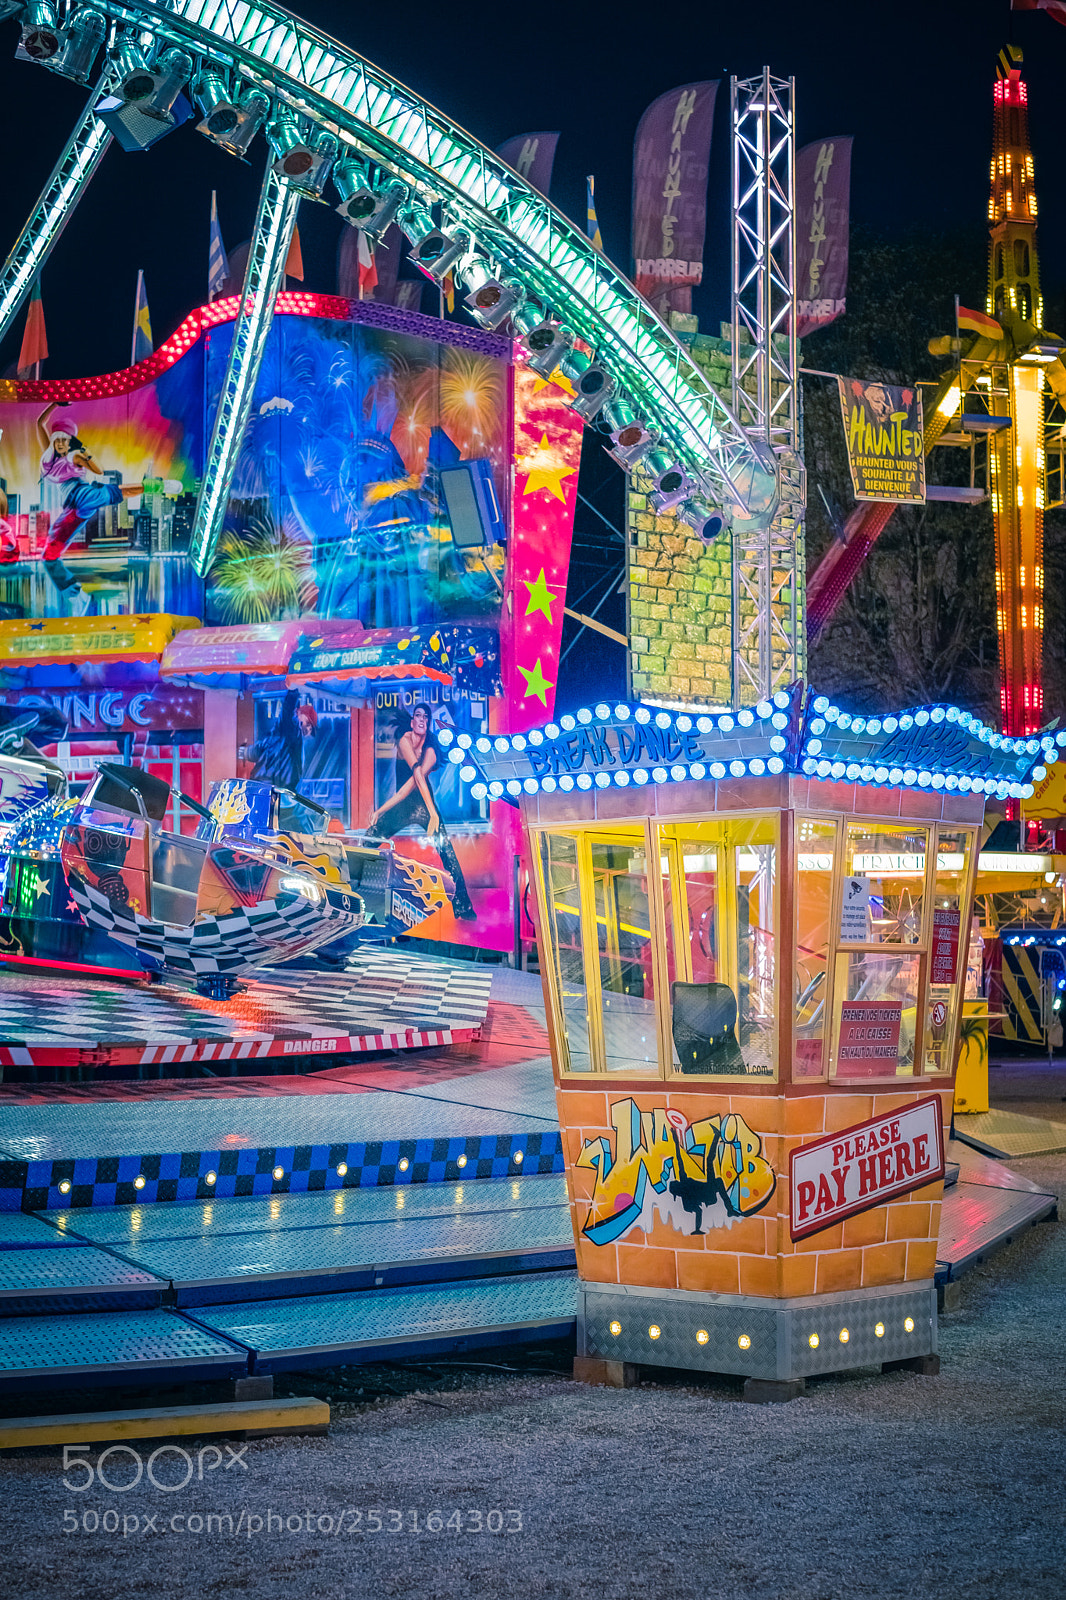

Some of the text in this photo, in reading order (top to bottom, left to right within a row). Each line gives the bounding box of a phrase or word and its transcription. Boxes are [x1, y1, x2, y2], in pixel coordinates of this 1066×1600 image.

[661, 90, 697, 257] HAUNTED
[809, 143, 835, 299] HAUNTED
[850, 404, 922, 457] HAUNTED
[856, 457, 918, 471] HAUNTED VOUS
[862, 468, 916, 482] SOUHAITE LA
[864, 479, 911, 493] BIENVENUE
[82, 632, 136, 650] VIBES
[376, 691, 399, 709] OUT
[404, 690, 421, 706] OF
[525, 723, 705, 776] BREAK DANCE
[842, 1009, 901, 1021] PRENEZ VOS TICKETS
[855, 1028, 866, 1040] LA
[866, 1028, 892, 1040] CAISSE
[283, 1039, 337, 1053] DANGER
[840, 1046, 849, 1059] EN
[849, 1046, 865, 1058] HAUT
[832, 1120, 901, 1166] PLEASE
[797, 1133, 930, 1221] PAY HERE
